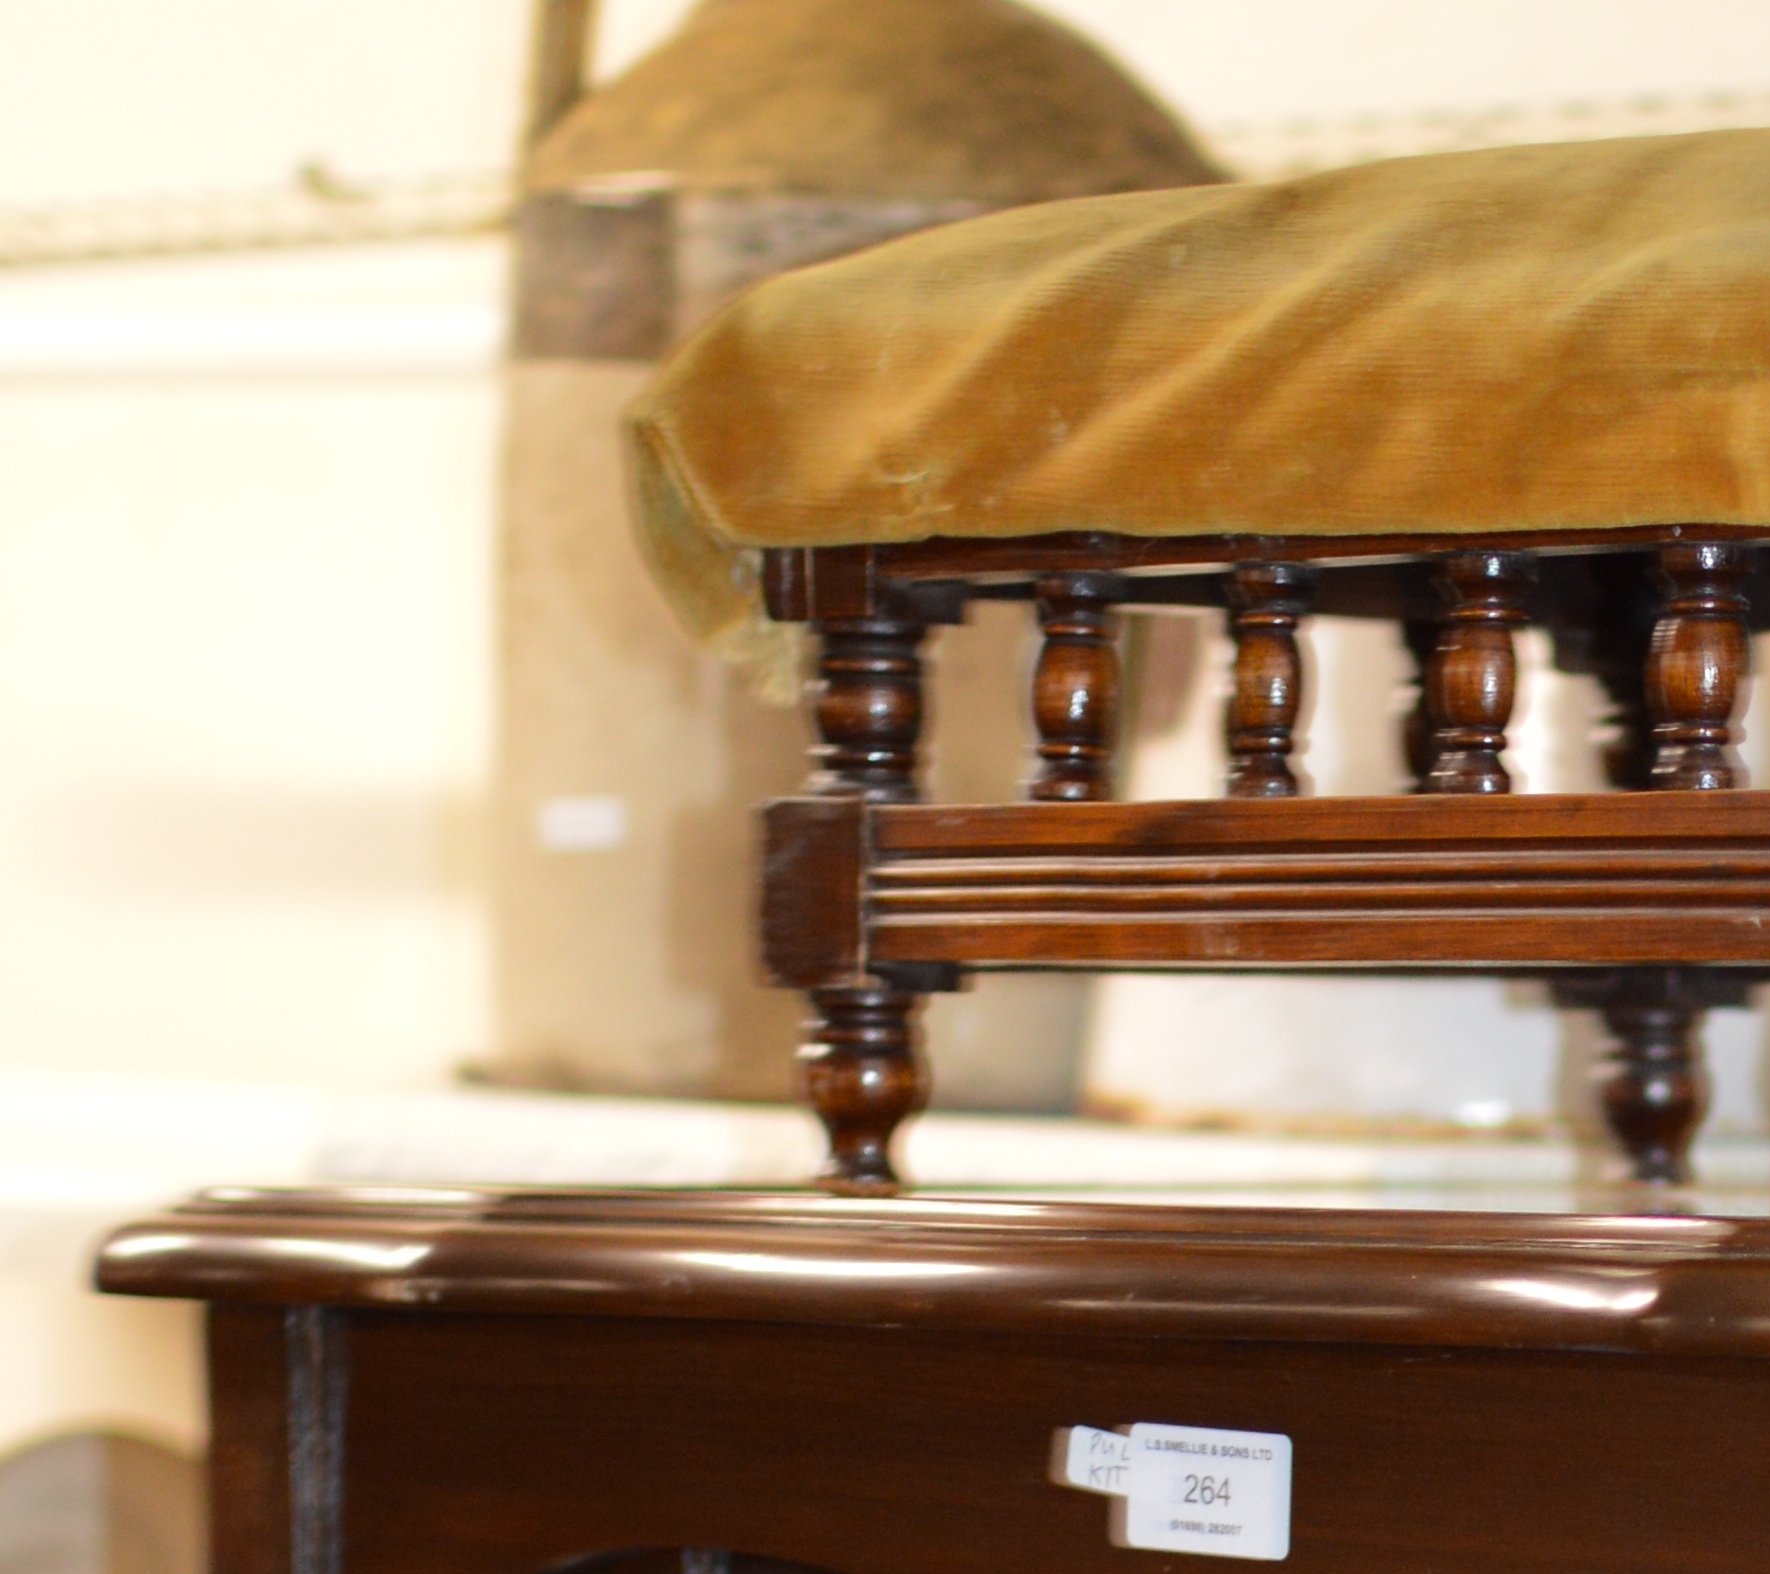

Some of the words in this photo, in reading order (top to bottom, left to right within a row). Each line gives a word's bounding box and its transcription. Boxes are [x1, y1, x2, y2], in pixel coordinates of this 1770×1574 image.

[1210, 1445, 1219, 1457] &
[1220, 1446, 1250, 1459] SONS
[1252, 1448, 1273, 1461] LTD
[1088, 1464, 1131, 1489] KIT
[1184, 1473, 1232, 1506] 264
